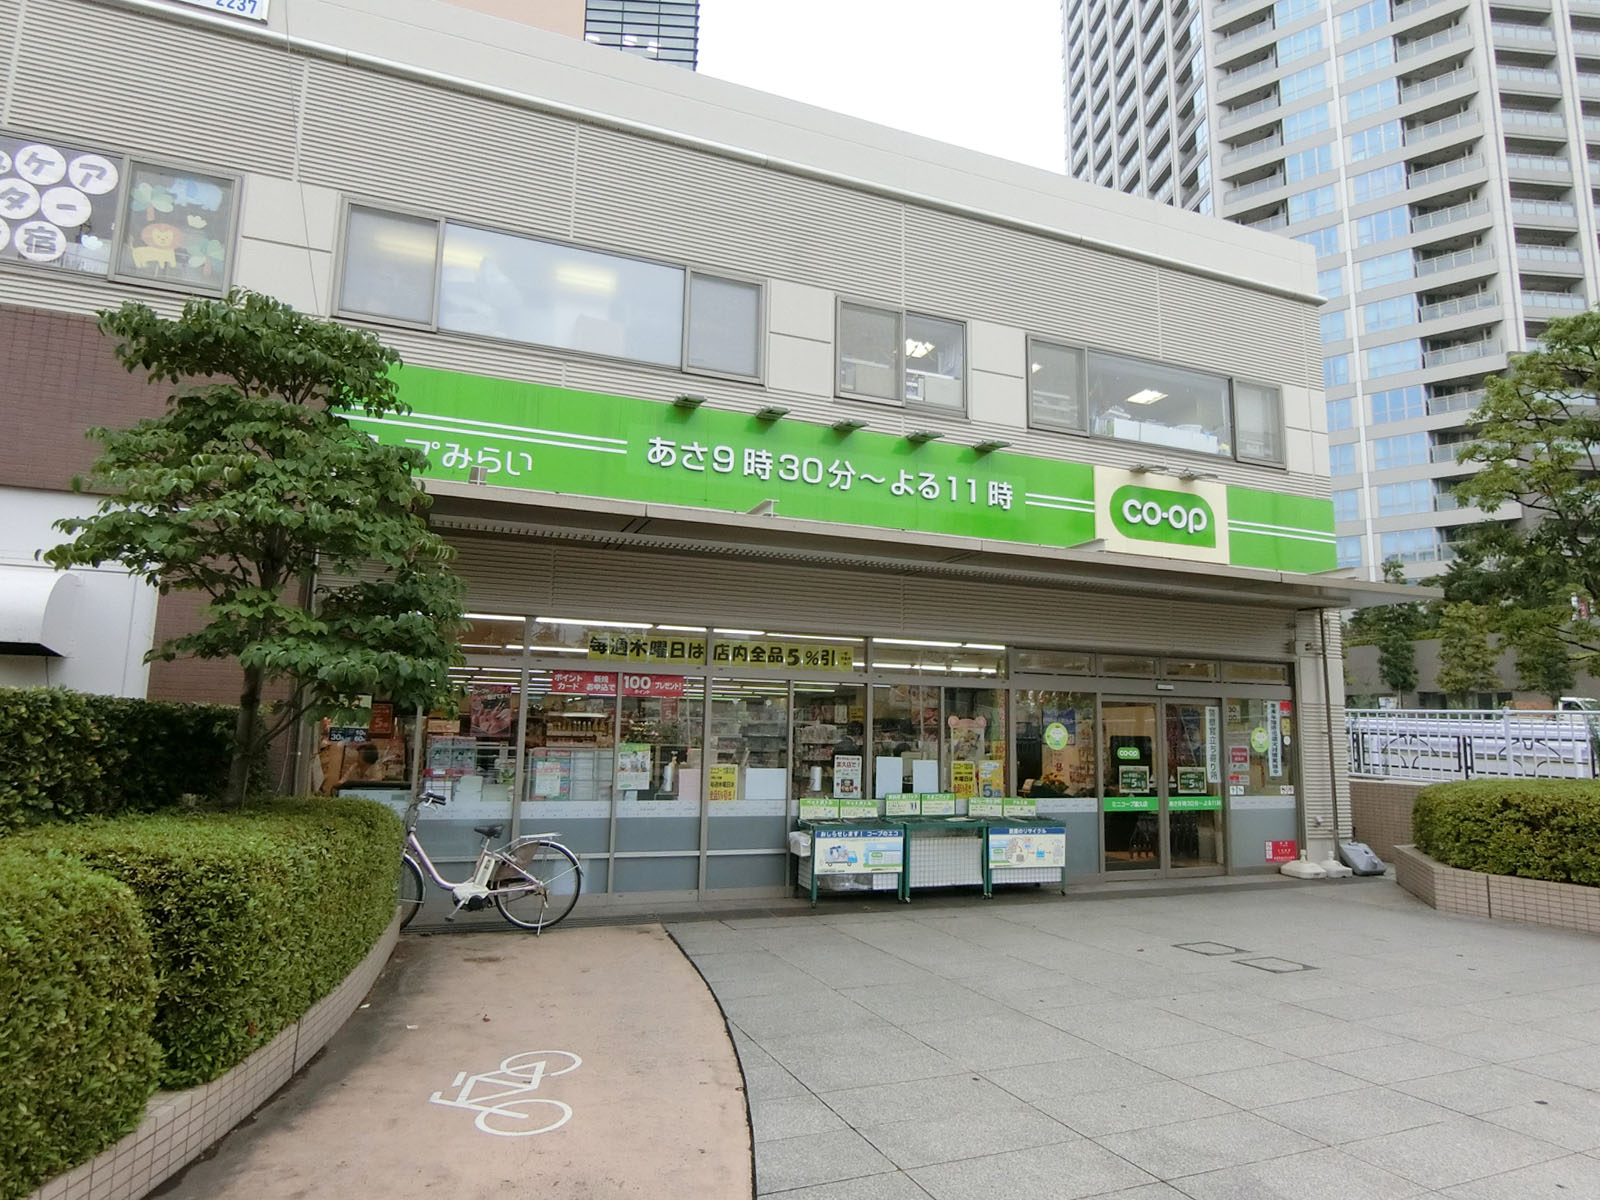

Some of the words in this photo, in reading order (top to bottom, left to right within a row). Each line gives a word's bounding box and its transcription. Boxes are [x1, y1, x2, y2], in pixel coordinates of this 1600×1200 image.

[360, 433, 533, 477] プみらい
[589, 636, 704, 660] 毎週木曜日は
[712, 643, 836, 667] 店内全品5%引
[554, 673, 583, 682] ポイント
[623, 675, 651, 690] 100
